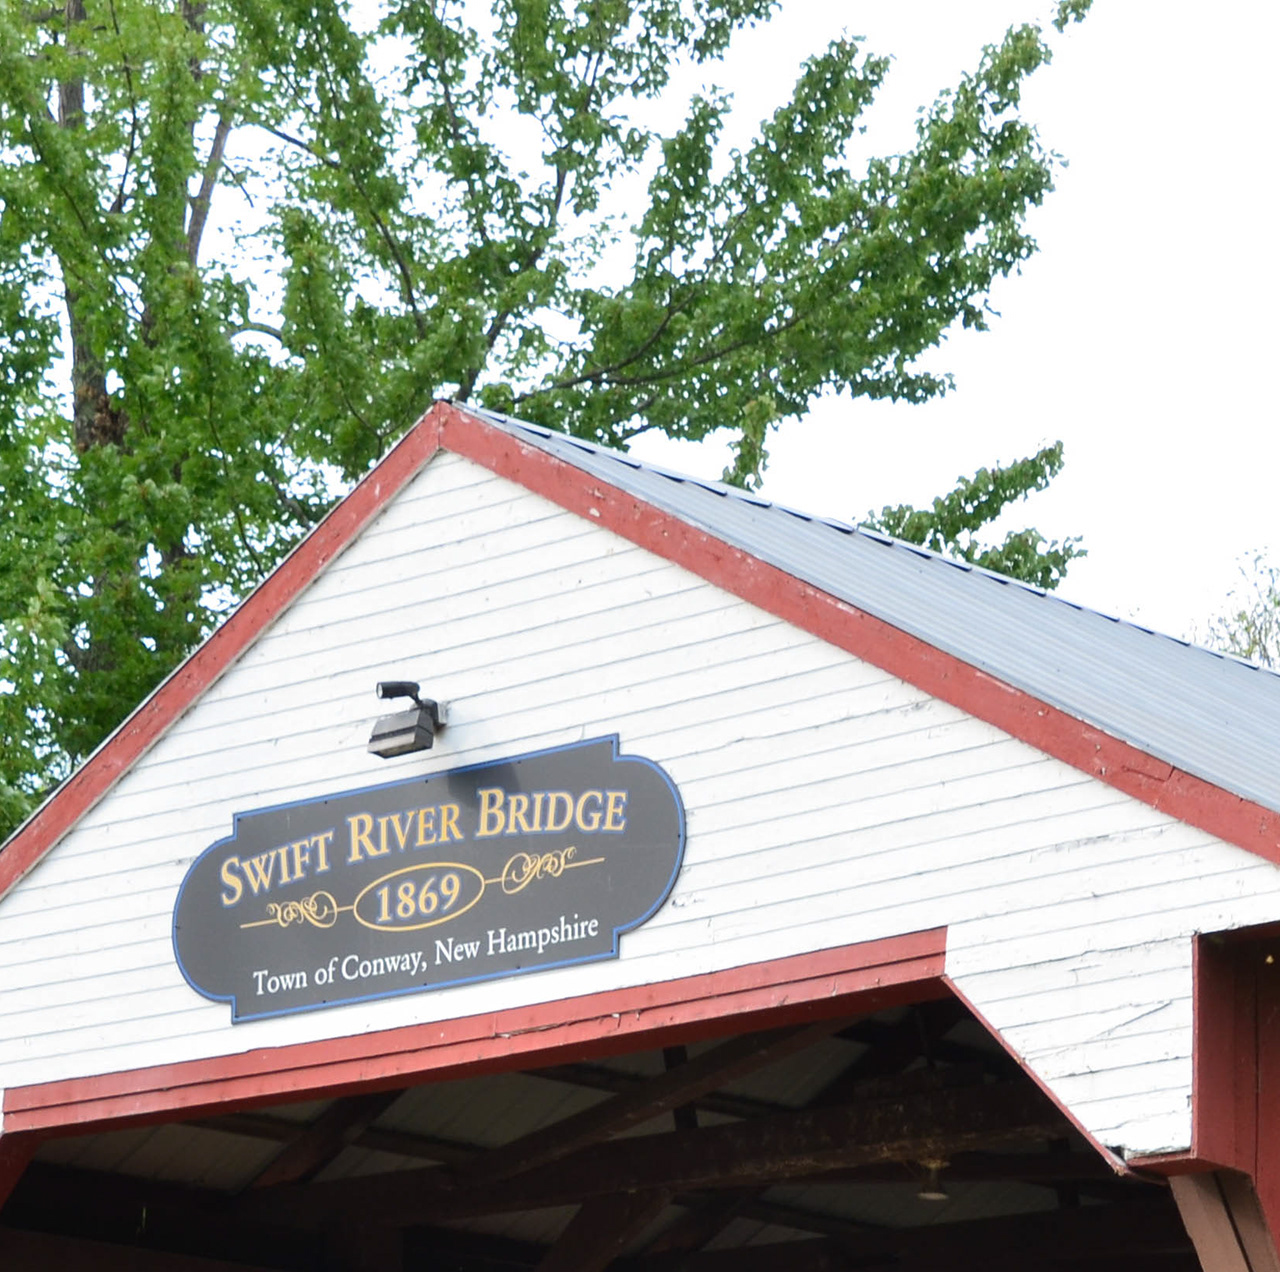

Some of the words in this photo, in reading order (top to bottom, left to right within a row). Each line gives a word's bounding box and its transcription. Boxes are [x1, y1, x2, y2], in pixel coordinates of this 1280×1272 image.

[220, 830, 334, 907] SWIFT
[346, 803, 464, 863] RIVER
[475, 787, 627, 838] BRIDGE
[377, 873, 461, 922] 1869
[252, 968, 309, 996] Town
[314, 956, 339, 986] of
[341, 951, 428, 981] Conway,
[434, 936, 481, 965] New
[486, 913, 599, 954] Hampshire
